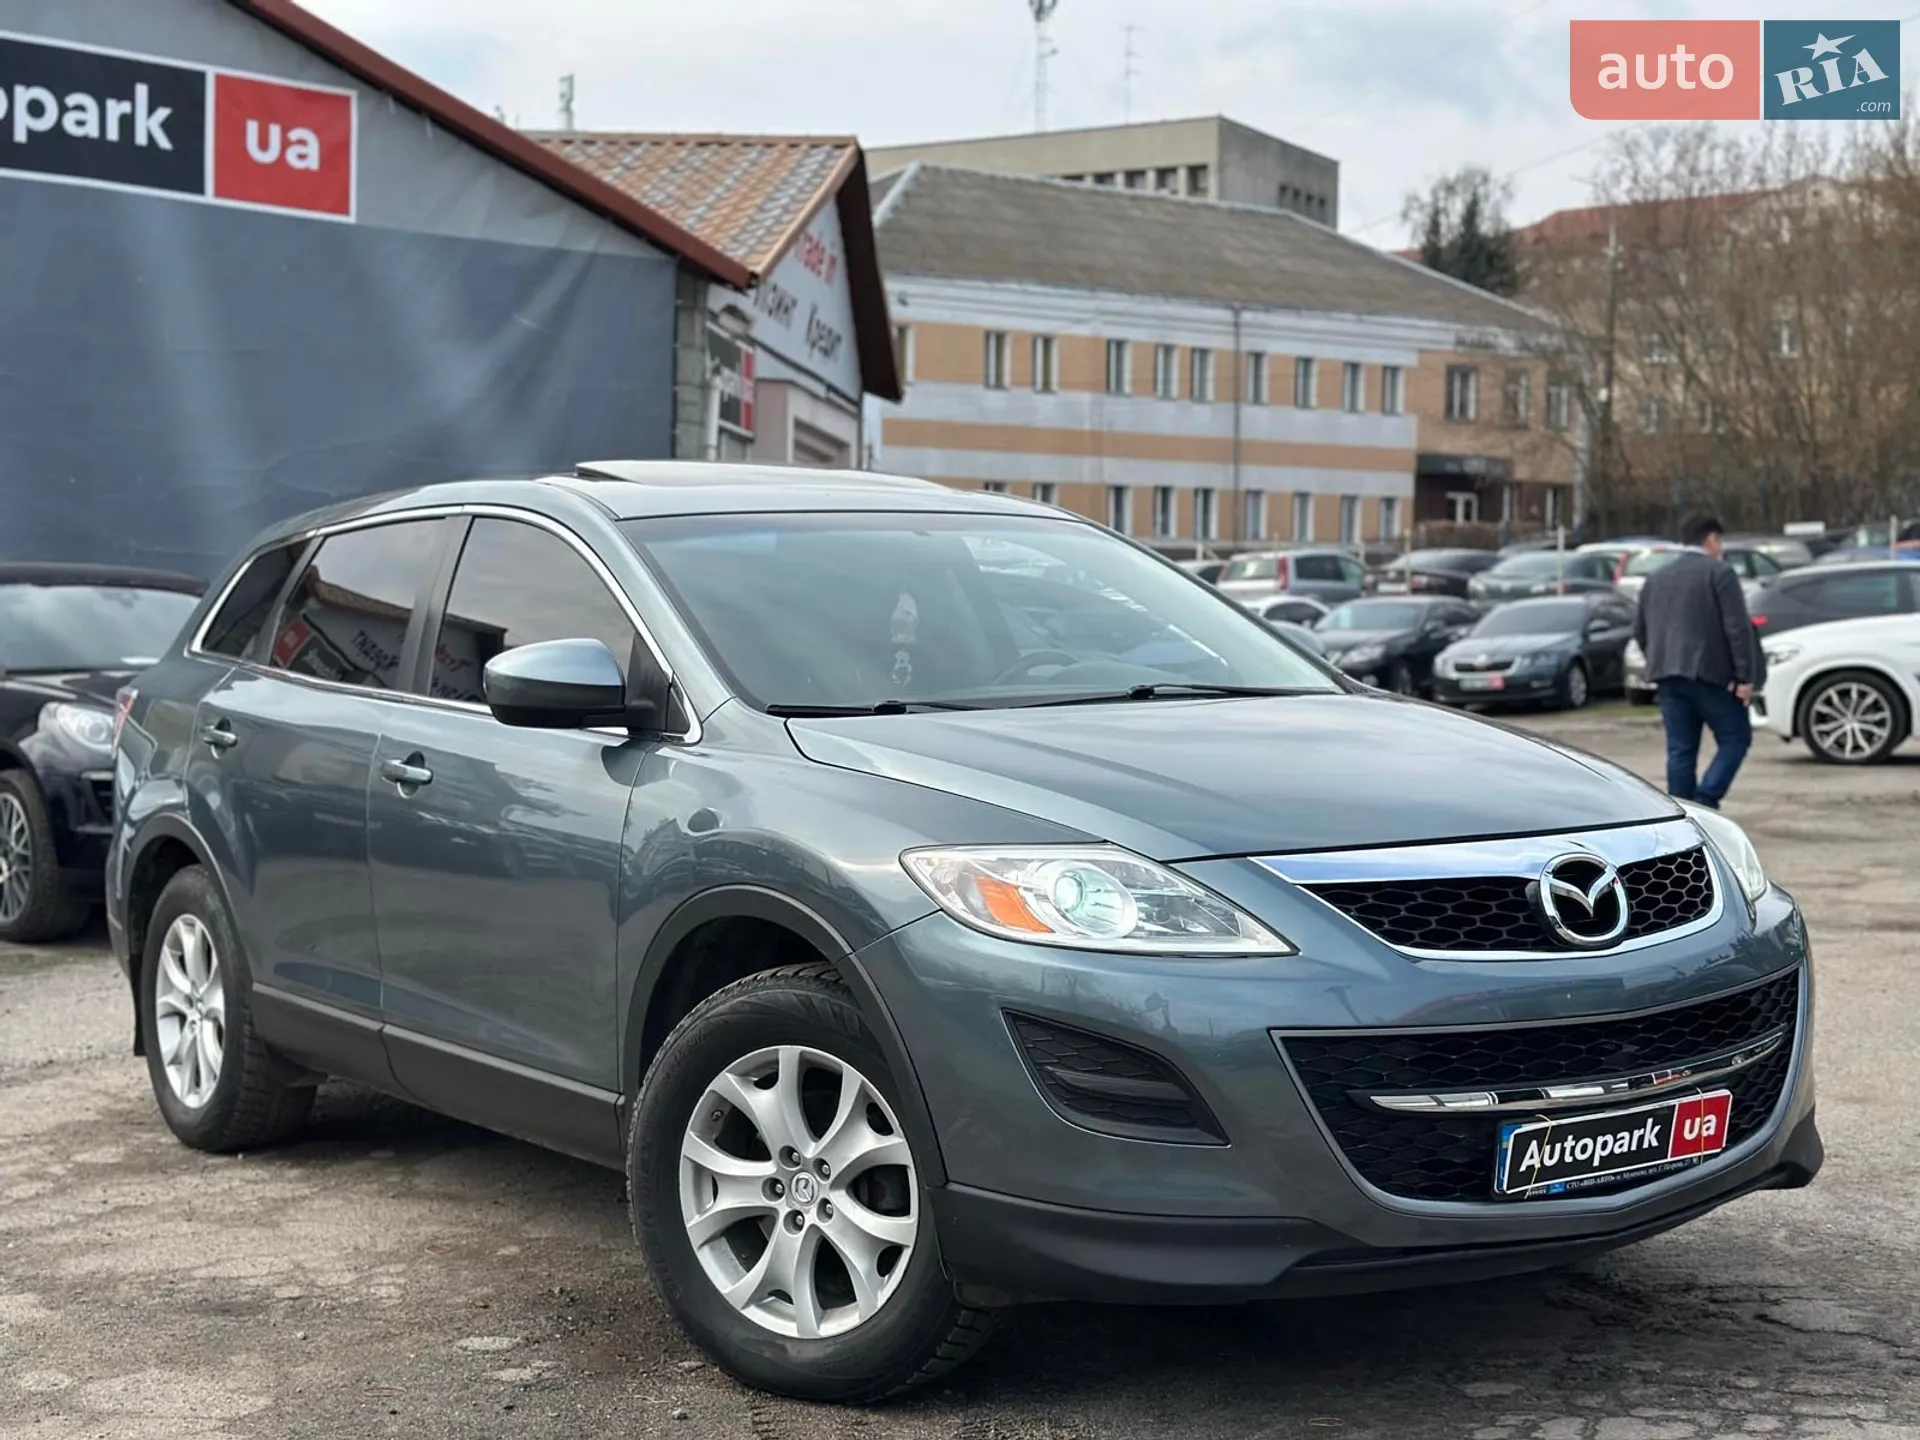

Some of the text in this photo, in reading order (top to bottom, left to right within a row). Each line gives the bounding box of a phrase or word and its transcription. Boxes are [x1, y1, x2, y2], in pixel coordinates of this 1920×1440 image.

[0, 82, 321, 172] park ua
[1518, 1117, 1663, 1173] Autopark
[1683, 1112, 1718, 1142] ua
